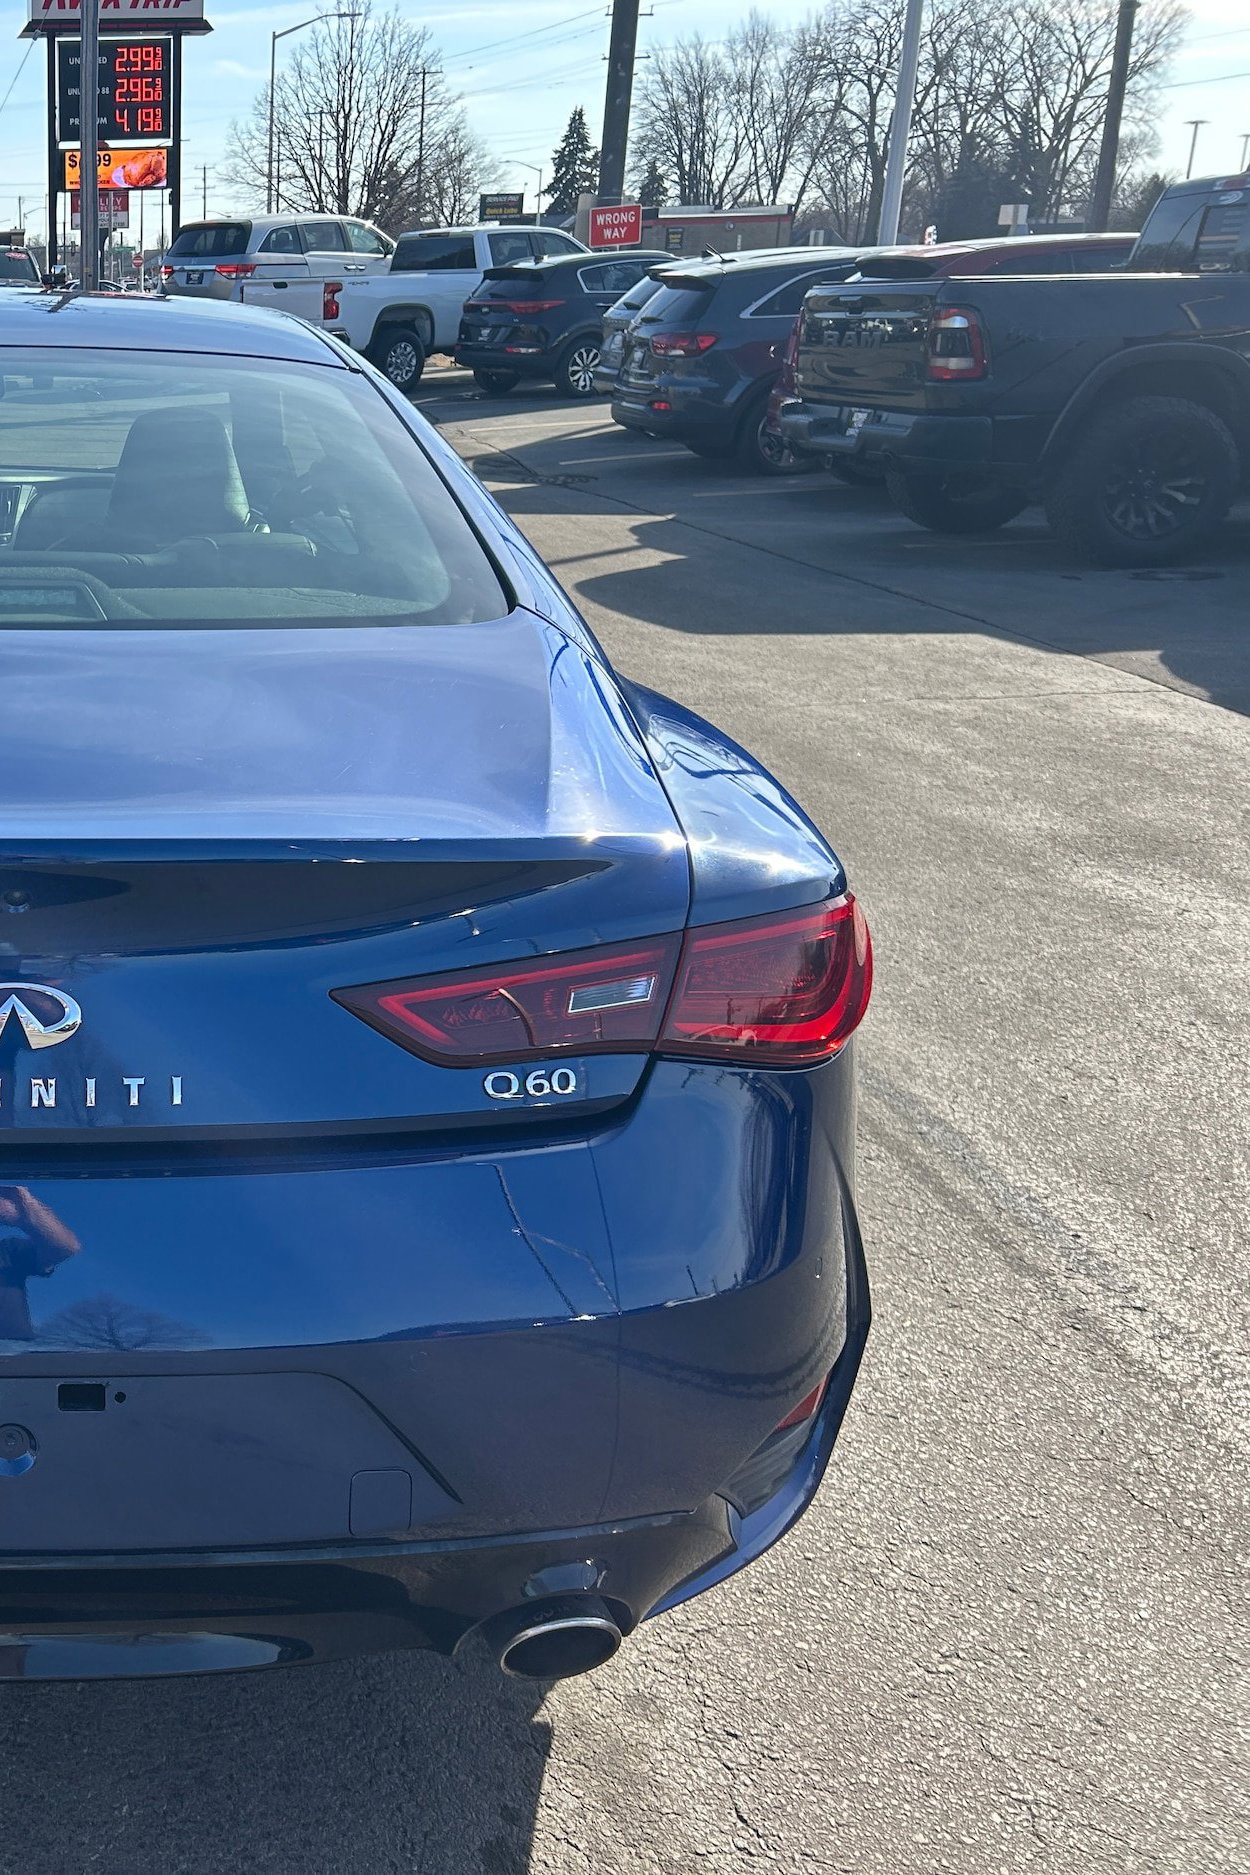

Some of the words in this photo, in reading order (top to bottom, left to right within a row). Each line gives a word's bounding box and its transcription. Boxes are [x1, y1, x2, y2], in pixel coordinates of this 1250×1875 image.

[68, 56, 108, 65] UNED
[596, 211, 636, 226] WRONG
[603, 227, 628, 240] WAY
[483, 1067, 578, 1100] Q60
